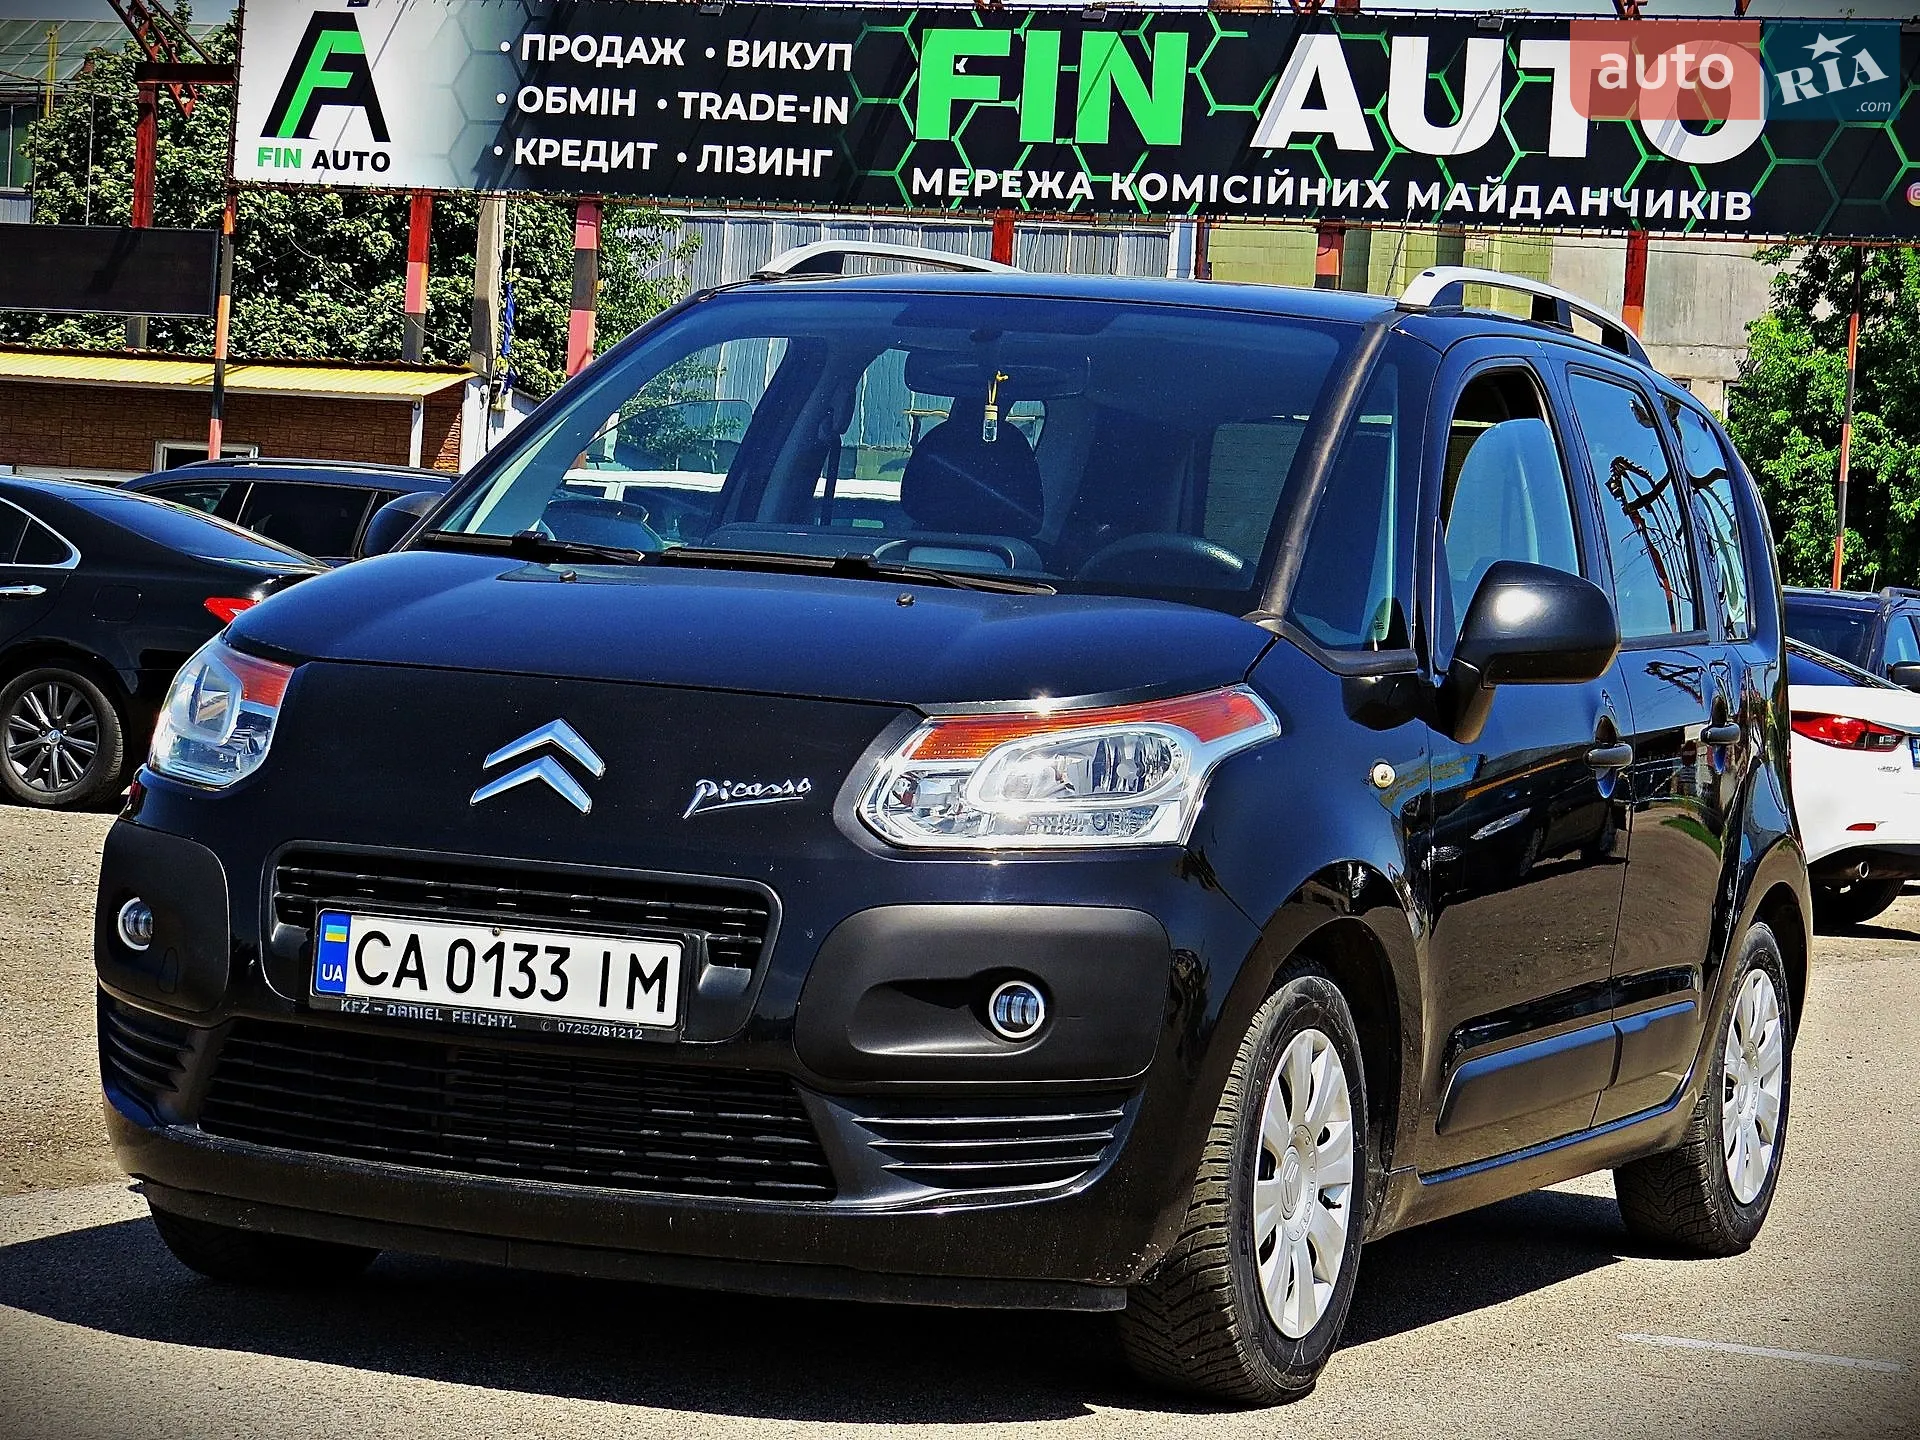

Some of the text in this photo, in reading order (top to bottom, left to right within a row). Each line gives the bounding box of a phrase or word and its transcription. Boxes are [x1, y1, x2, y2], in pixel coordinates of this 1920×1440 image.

[521, 33, 853, 72] ПРОДАЖ ВИКУП
[516, 88, 637, 117] ОБМІН
[677, 91, 849, 125] TRADE-IN
[915, 29, 1769, 164] FIN AUTO
[257, 147, 391, 172] FIN AUTO
[514, 138, 833, 177] КРЕДИТ ЛІЗИНГ
[911, 167, 1753, 221] МЕРЕЖА КОМІСІЙНИХ МАЙДАНЧИКІВ
[682, 778, 812, 820] Picasso
[321, 963, 344, 983] UA
[354, 930, 428, 991] CA
[446, 938, 571, 1002] 0133
[452, 1010, 517, 1029] FEICHTL
[558, 1021, 643, 1040] 07252/81212
